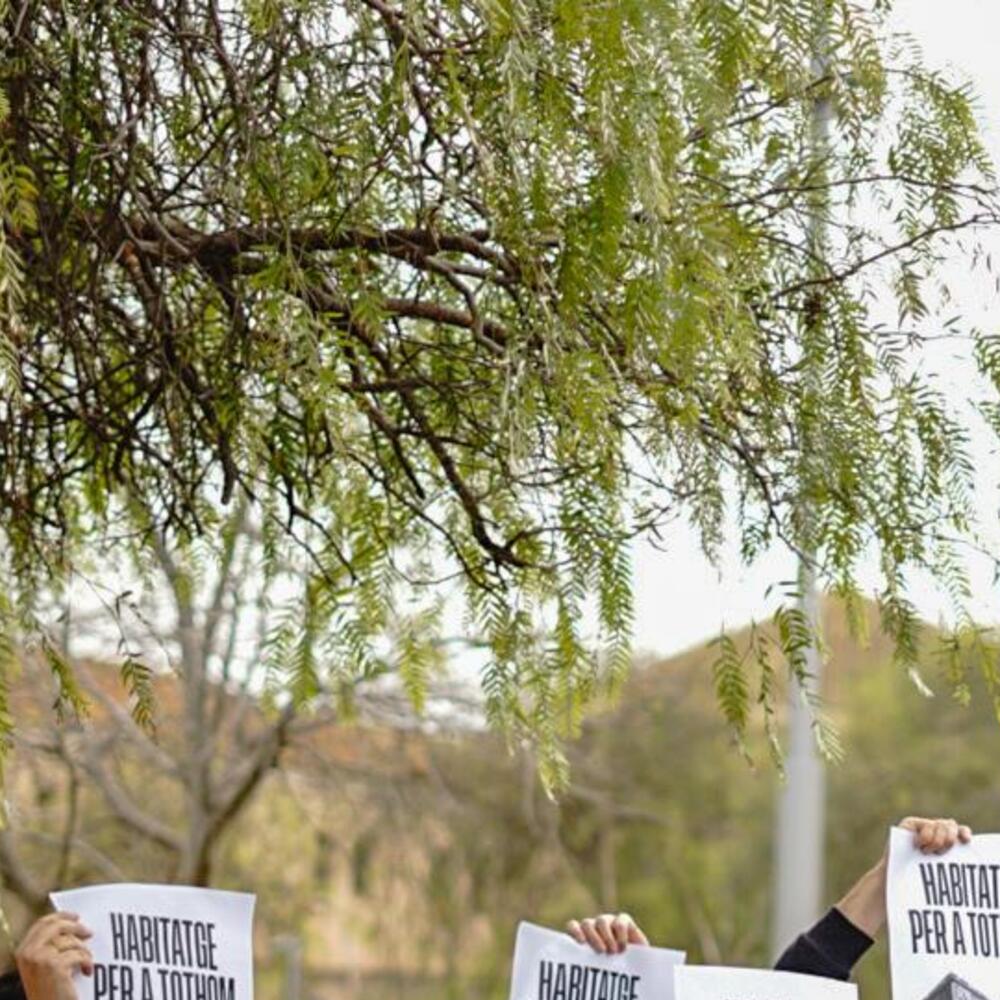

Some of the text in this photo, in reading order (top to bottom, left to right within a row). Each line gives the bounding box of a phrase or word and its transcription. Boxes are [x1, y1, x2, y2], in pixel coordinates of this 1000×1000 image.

[110, 912, 218, 971] HABITATGE
[908, 909, 949, 954] PER
[954, 911, 967, 955] A
